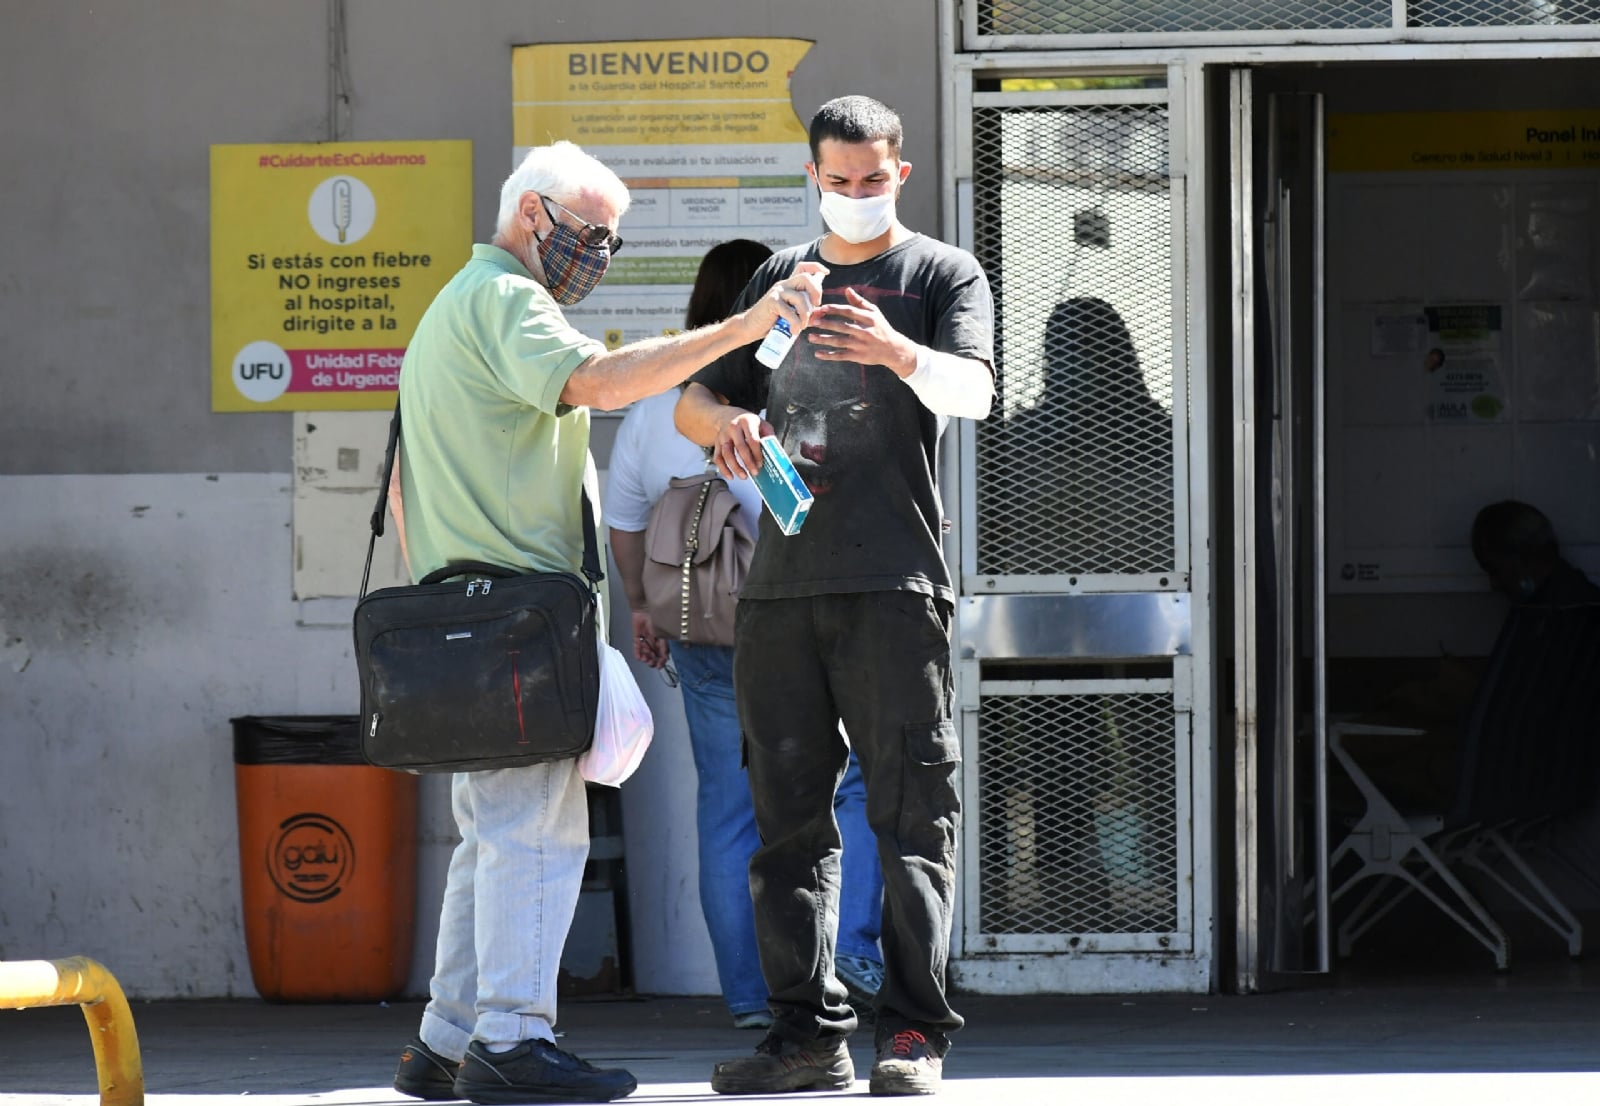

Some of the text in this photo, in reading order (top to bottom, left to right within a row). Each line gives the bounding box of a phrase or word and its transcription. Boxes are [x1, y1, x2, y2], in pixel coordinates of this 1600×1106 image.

[568, 50, 770, 76] BIENVENIDO
[569, 83, 576, 92] a
[579, 81, 590, 92] la
[591, 80, 635, 92] Guardia
[639, 79, 657, 91] del
[659, 79, 707, 92] Hospital
[1526, 126, 1576, 143] Panel
[258, 152, 427, 169] #CuidarteEsCuidarnos
[629, 157, 640, 166] se
[643, 154, 687, 166] evaluará
[690, 155, 698, 165] si
[700, 156, 712, 165] tu
[714, 153, 761, 165] situación
[1411, 151, 1457, 163] Centro
[1459, 151, 1474, 162] de
[1478, 150, 1511, 162] Salud
[1514, 150, 1543, 161] Nivel
[1545, 150, 1553, 161] 3
[681, 197, 727, 206] URGENCIA
[743, 196, 803, 205] SIN URGENCIA
[688, 205, 720, 214] MENOR
[248, 251, 431, 270] Si estás con fiebre
[279, 274, 401, 293] NO ingreses
[284, 294, 396, 313] al hospital,
[636, 305, 672, 317] hospital
[283, 315, 397, 334] dirigite a la
[306, 353, 364, 369] Unidad
[240, 364, 284, 380] UFU
[312, 373, 333, 387] de
